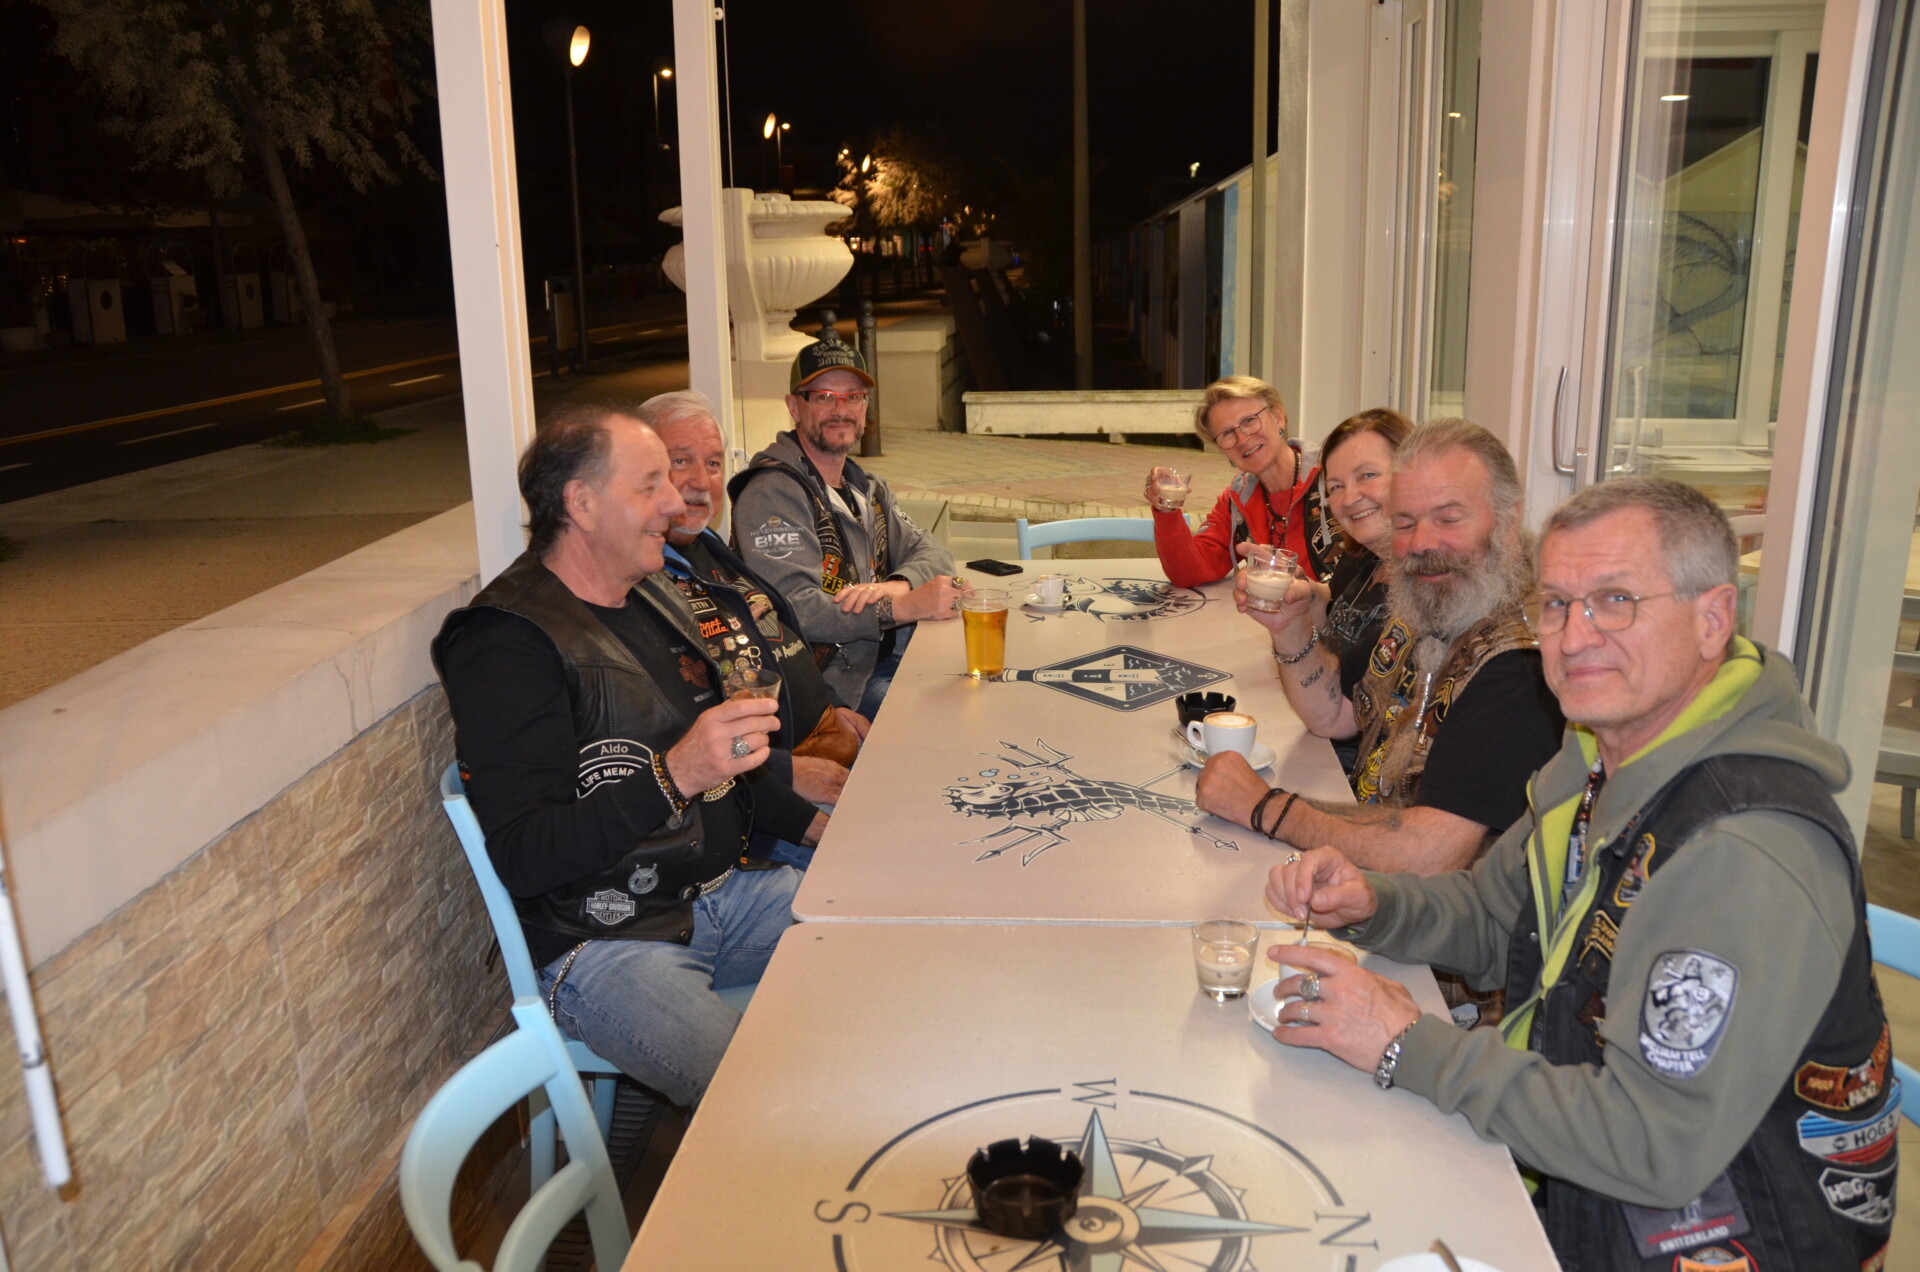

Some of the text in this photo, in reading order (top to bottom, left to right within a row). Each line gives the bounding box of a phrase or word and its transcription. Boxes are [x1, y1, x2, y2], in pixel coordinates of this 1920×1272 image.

[600, 743, 629, 756] Aldo
[581, 771, 602, 788] LIFE
[590, 902, 631, 912] HARLEY-DAVIDSON
[1681, 1048, 1708, 1063] TELL
[1853, 1119, 1887, 1147] HOG
[1826, 1178, 1865, 1204] HOG
[1314, 1210, 1379, 1252] N
[1659, 1224, 1730, 1254] SWITZERLAND
